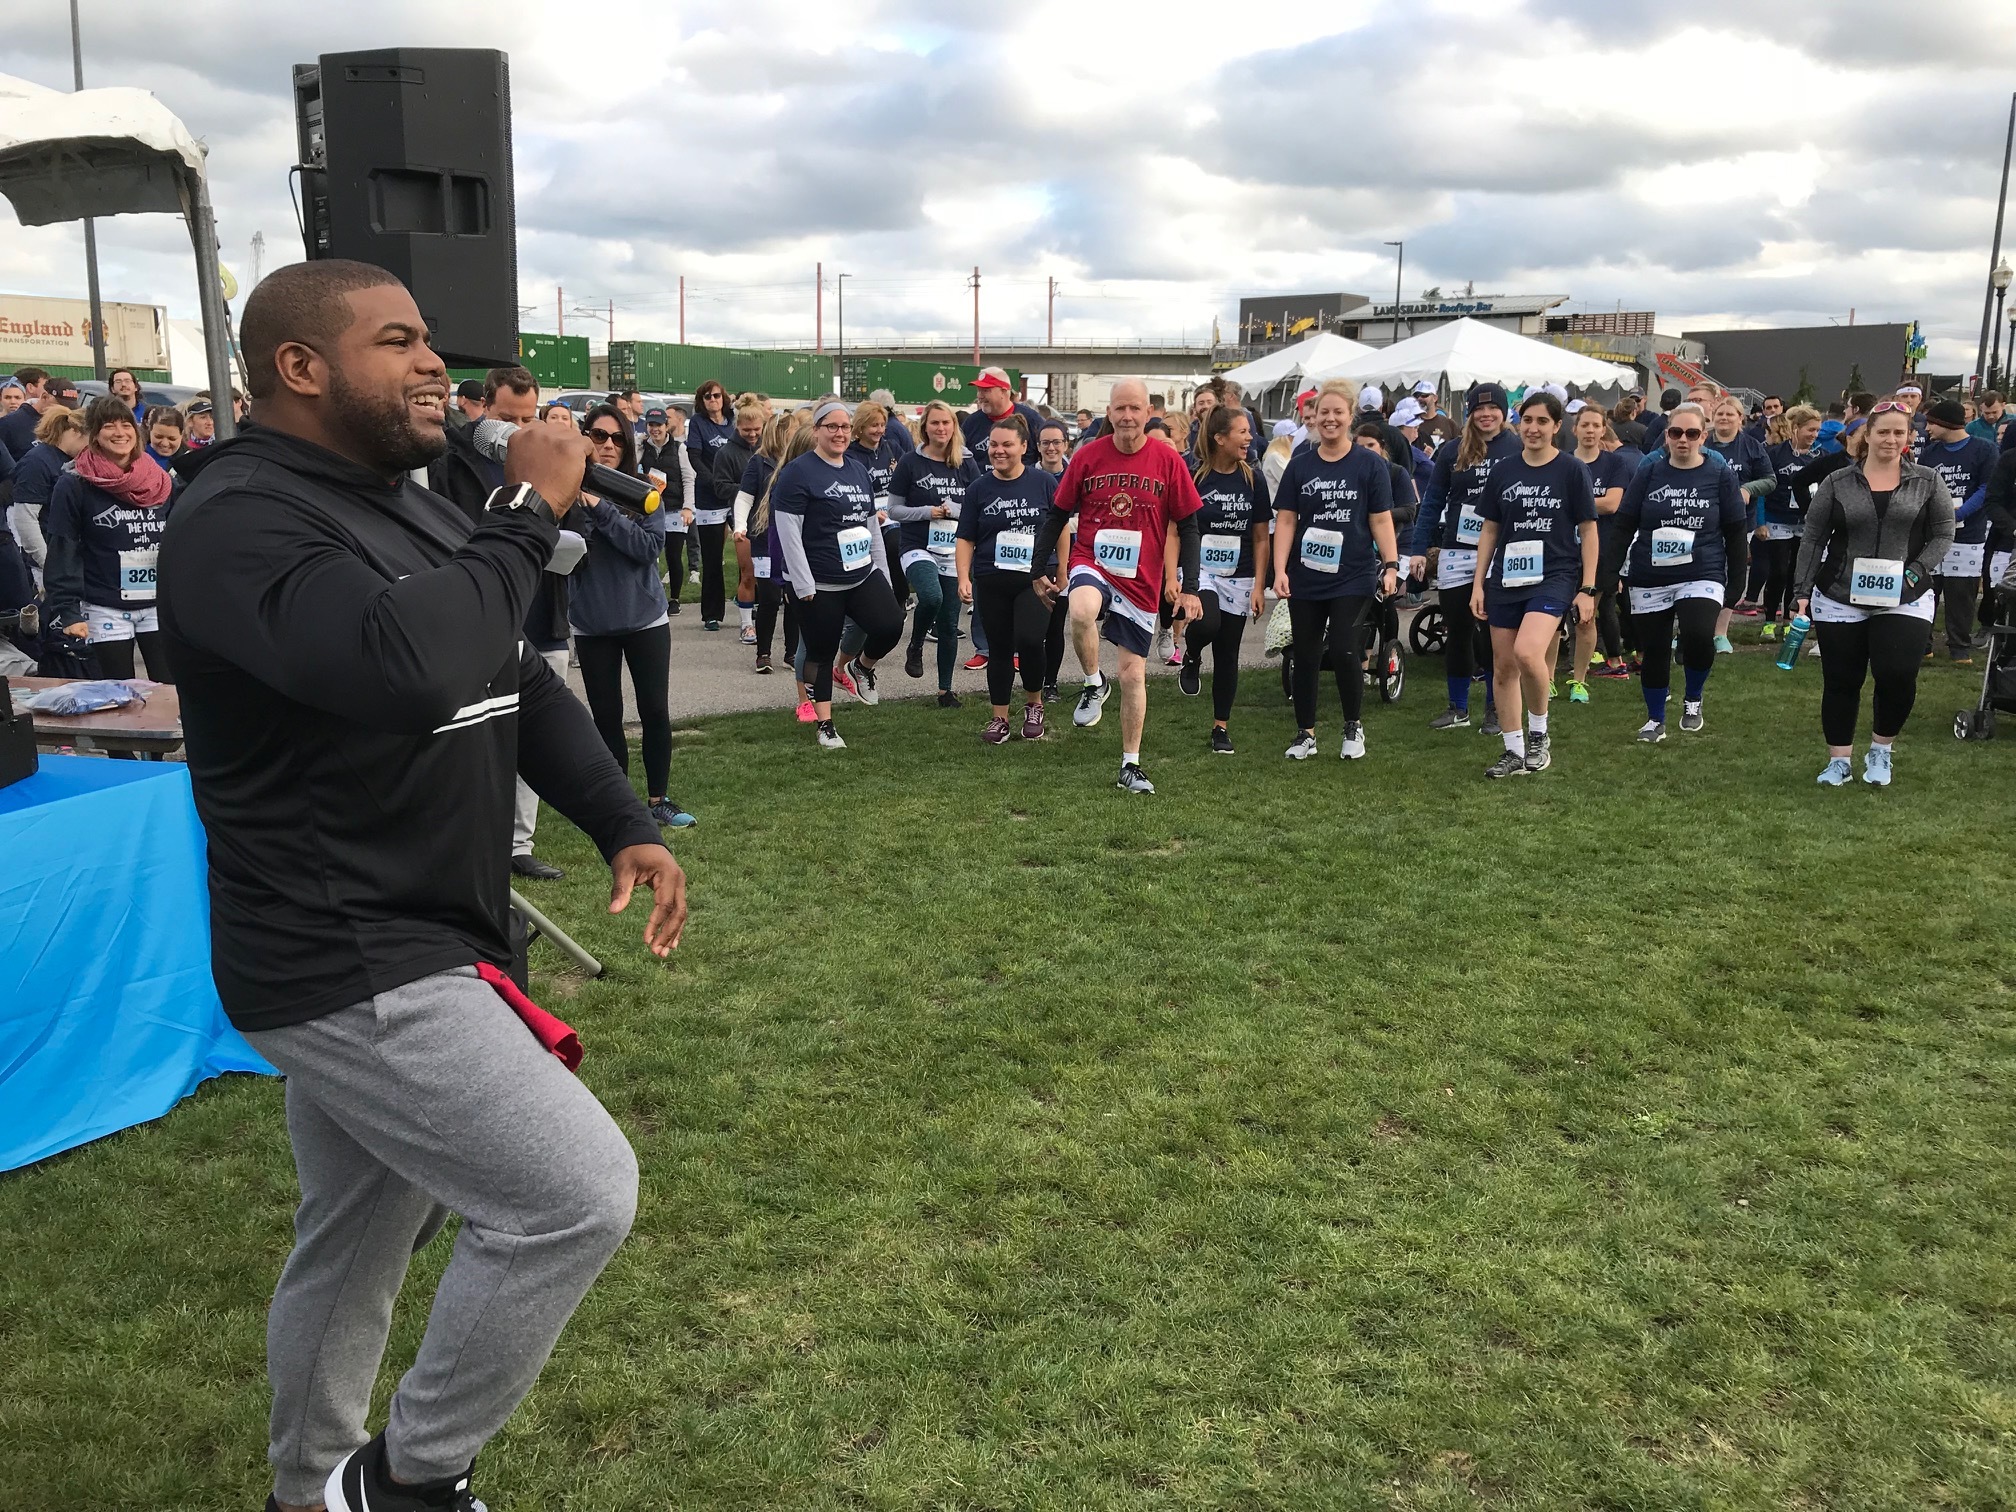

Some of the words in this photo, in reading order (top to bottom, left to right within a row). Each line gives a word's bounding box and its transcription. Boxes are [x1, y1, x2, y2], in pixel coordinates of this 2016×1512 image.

[0, 317, 74, 338] England
[1083, 473, 1165, 497] VETERAN
[1315, 480, 1336, 489] DARCY
[1338, 479, 1347, 489] &
[1321, 490, 1333, 500] THE
[1333, 490, 1358, 500] POLYPS
[1516, 485, 1540, 496] DARCY
[1541, 485, 1551, 497] &
[1593, 487, 1606, 496] OLY
[1665, 488, 1687, 498] DARCY
[1690, 487, 1699, 498] &
[1020, 498, 1028, 507] &
[1325, 500, 1338, 509] with
[1522, 497, 1534, 508] THE
[1534, 498, 1562, 509] POLYPS
[1671, 498, 1684, 508] THE
[1684, 499, 1710, 509] POLYPS
[114, 509, 144, 521] DARCY
[147, 509, 157, 520] &
[1005, 509, 1017, 519] THE
[1526, 508, 1539, 517] with
[1674, 507, 1690, 516] with
[126, 521, 142, 534] THE
[142, 521, 166, 533] POLYP
[1463, 518, 1482, 532] 329
[133, 533, 151, 544] with
[934, 530, 956, 544] 3312
[1000, 546, 1028, 560] 3504
[1100, 544, 1132, 561] 3701
[1306, 542, 1335, 559] 3205
[1657, 541, 1686, 554] 3524
[1206, 549, 1235, 563] 3354
[1507, 557, 1534, 572] 3601
[129, 569, 157, 583] 326
[1858, 574, 1895, 591] 3648
